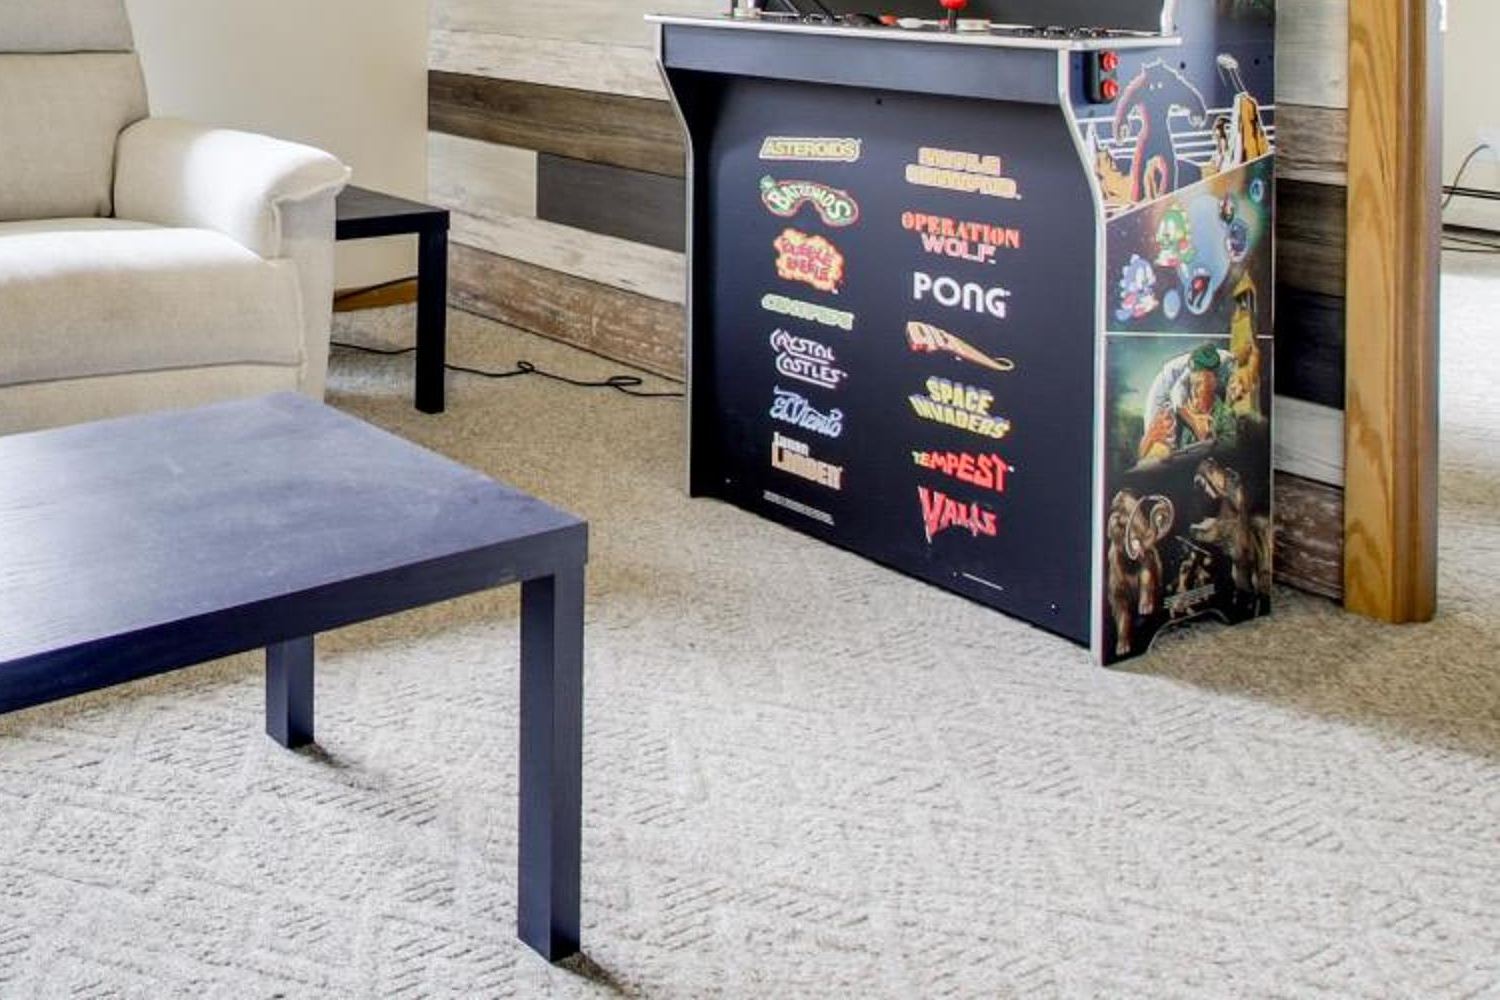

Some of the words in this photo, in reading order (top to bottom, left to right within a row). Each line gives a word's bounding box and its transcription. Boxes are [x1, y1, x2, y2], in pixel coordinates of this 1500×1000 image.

[901, 211, 1020, 249] OPERATION
[921, 232, 996, 263] WOLF
[913, 271, 1007, 318] PONG
[775, 352, 840, 389] CASTLES
[908, 393, 1011, 439] INVADERS
[926, 375, 995, 416] SPACE
[911, 450, 1008, 494] TEMPEST
